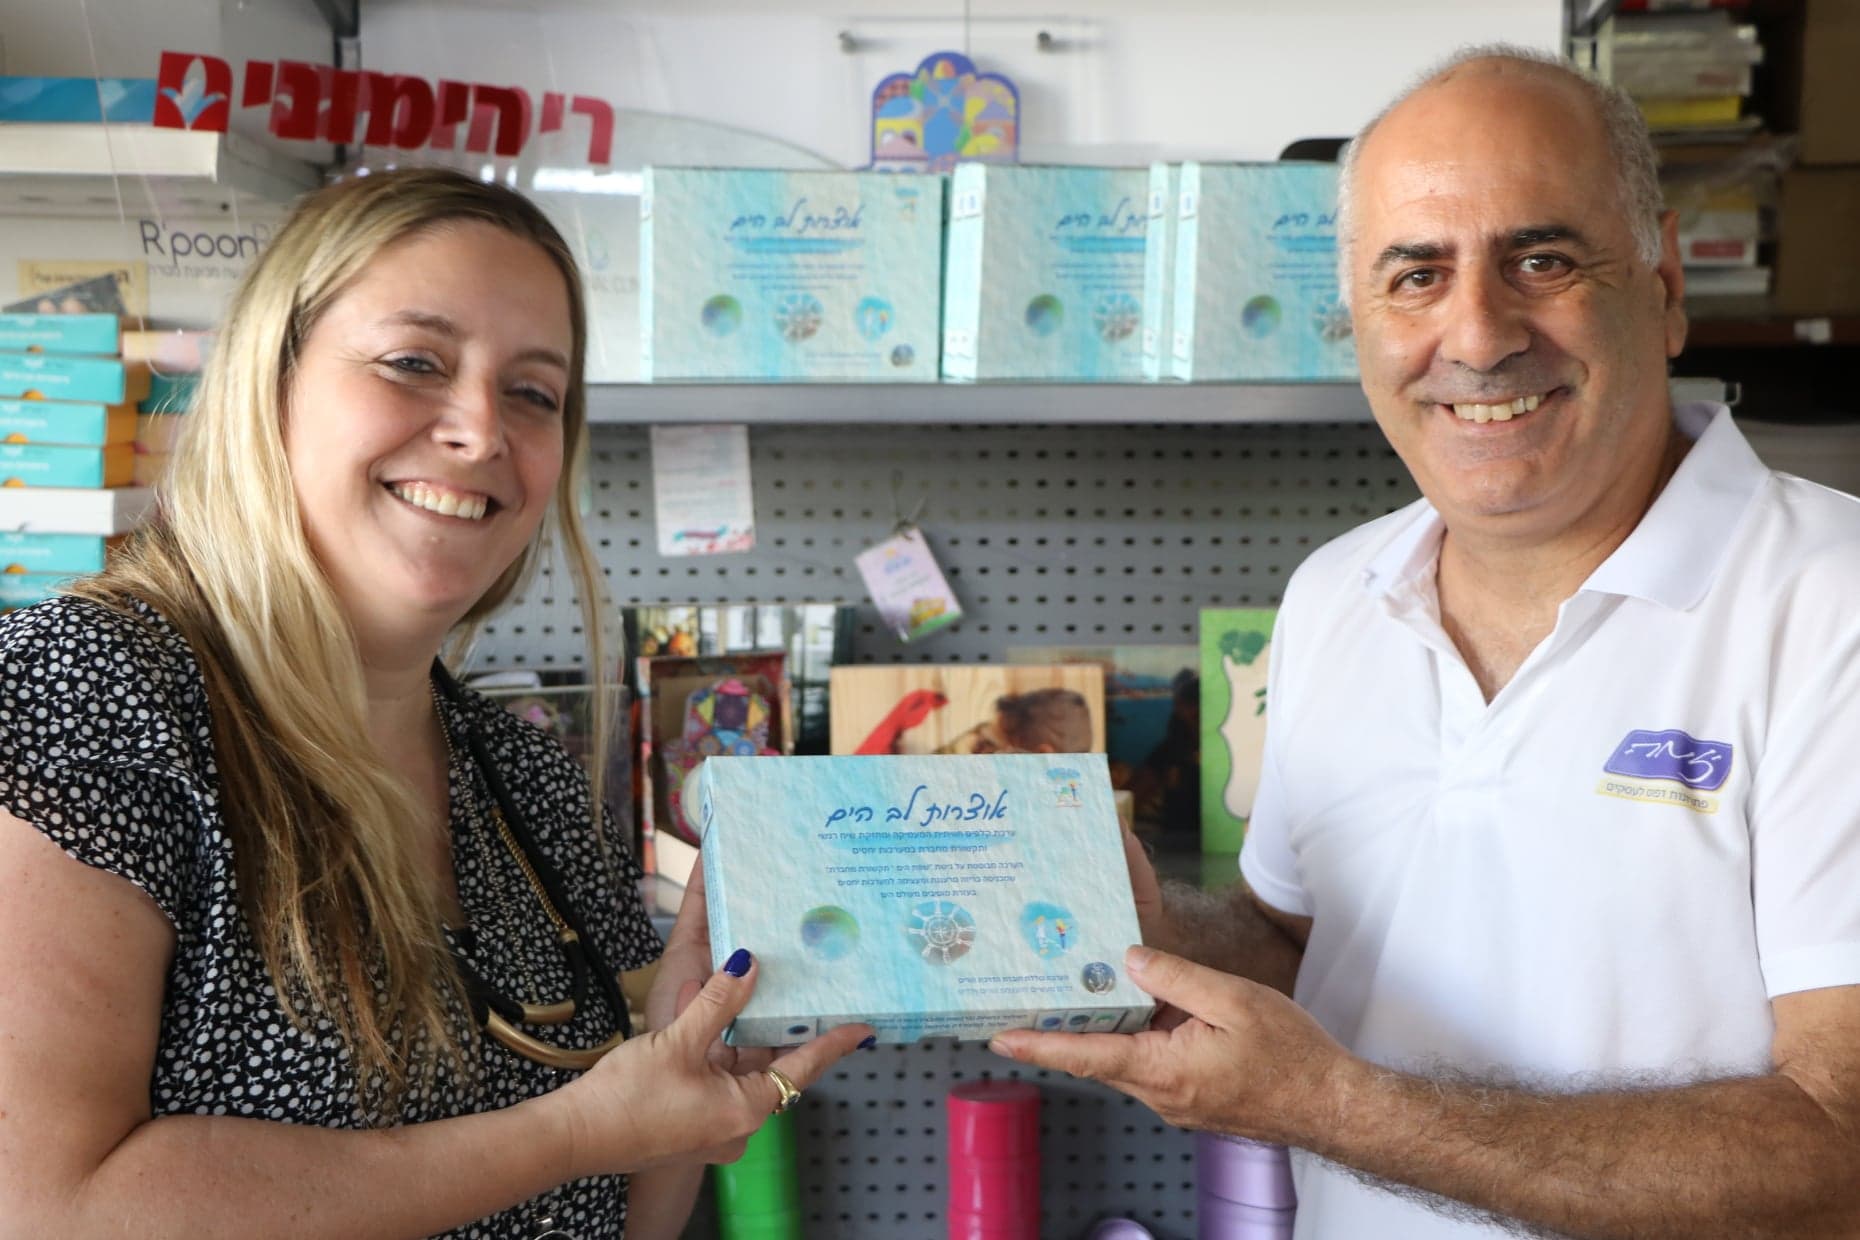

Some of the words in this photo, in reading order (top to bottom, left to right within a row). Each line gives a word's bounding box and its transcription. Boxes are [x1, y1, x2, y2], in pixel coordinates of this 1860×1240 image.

[886, 784, 928, 824] לב
[1606, 782, 1645, 797] לעסקים
[825, 805, 874, 828] הים
[920, 789, 1008, 828] אוצרות
